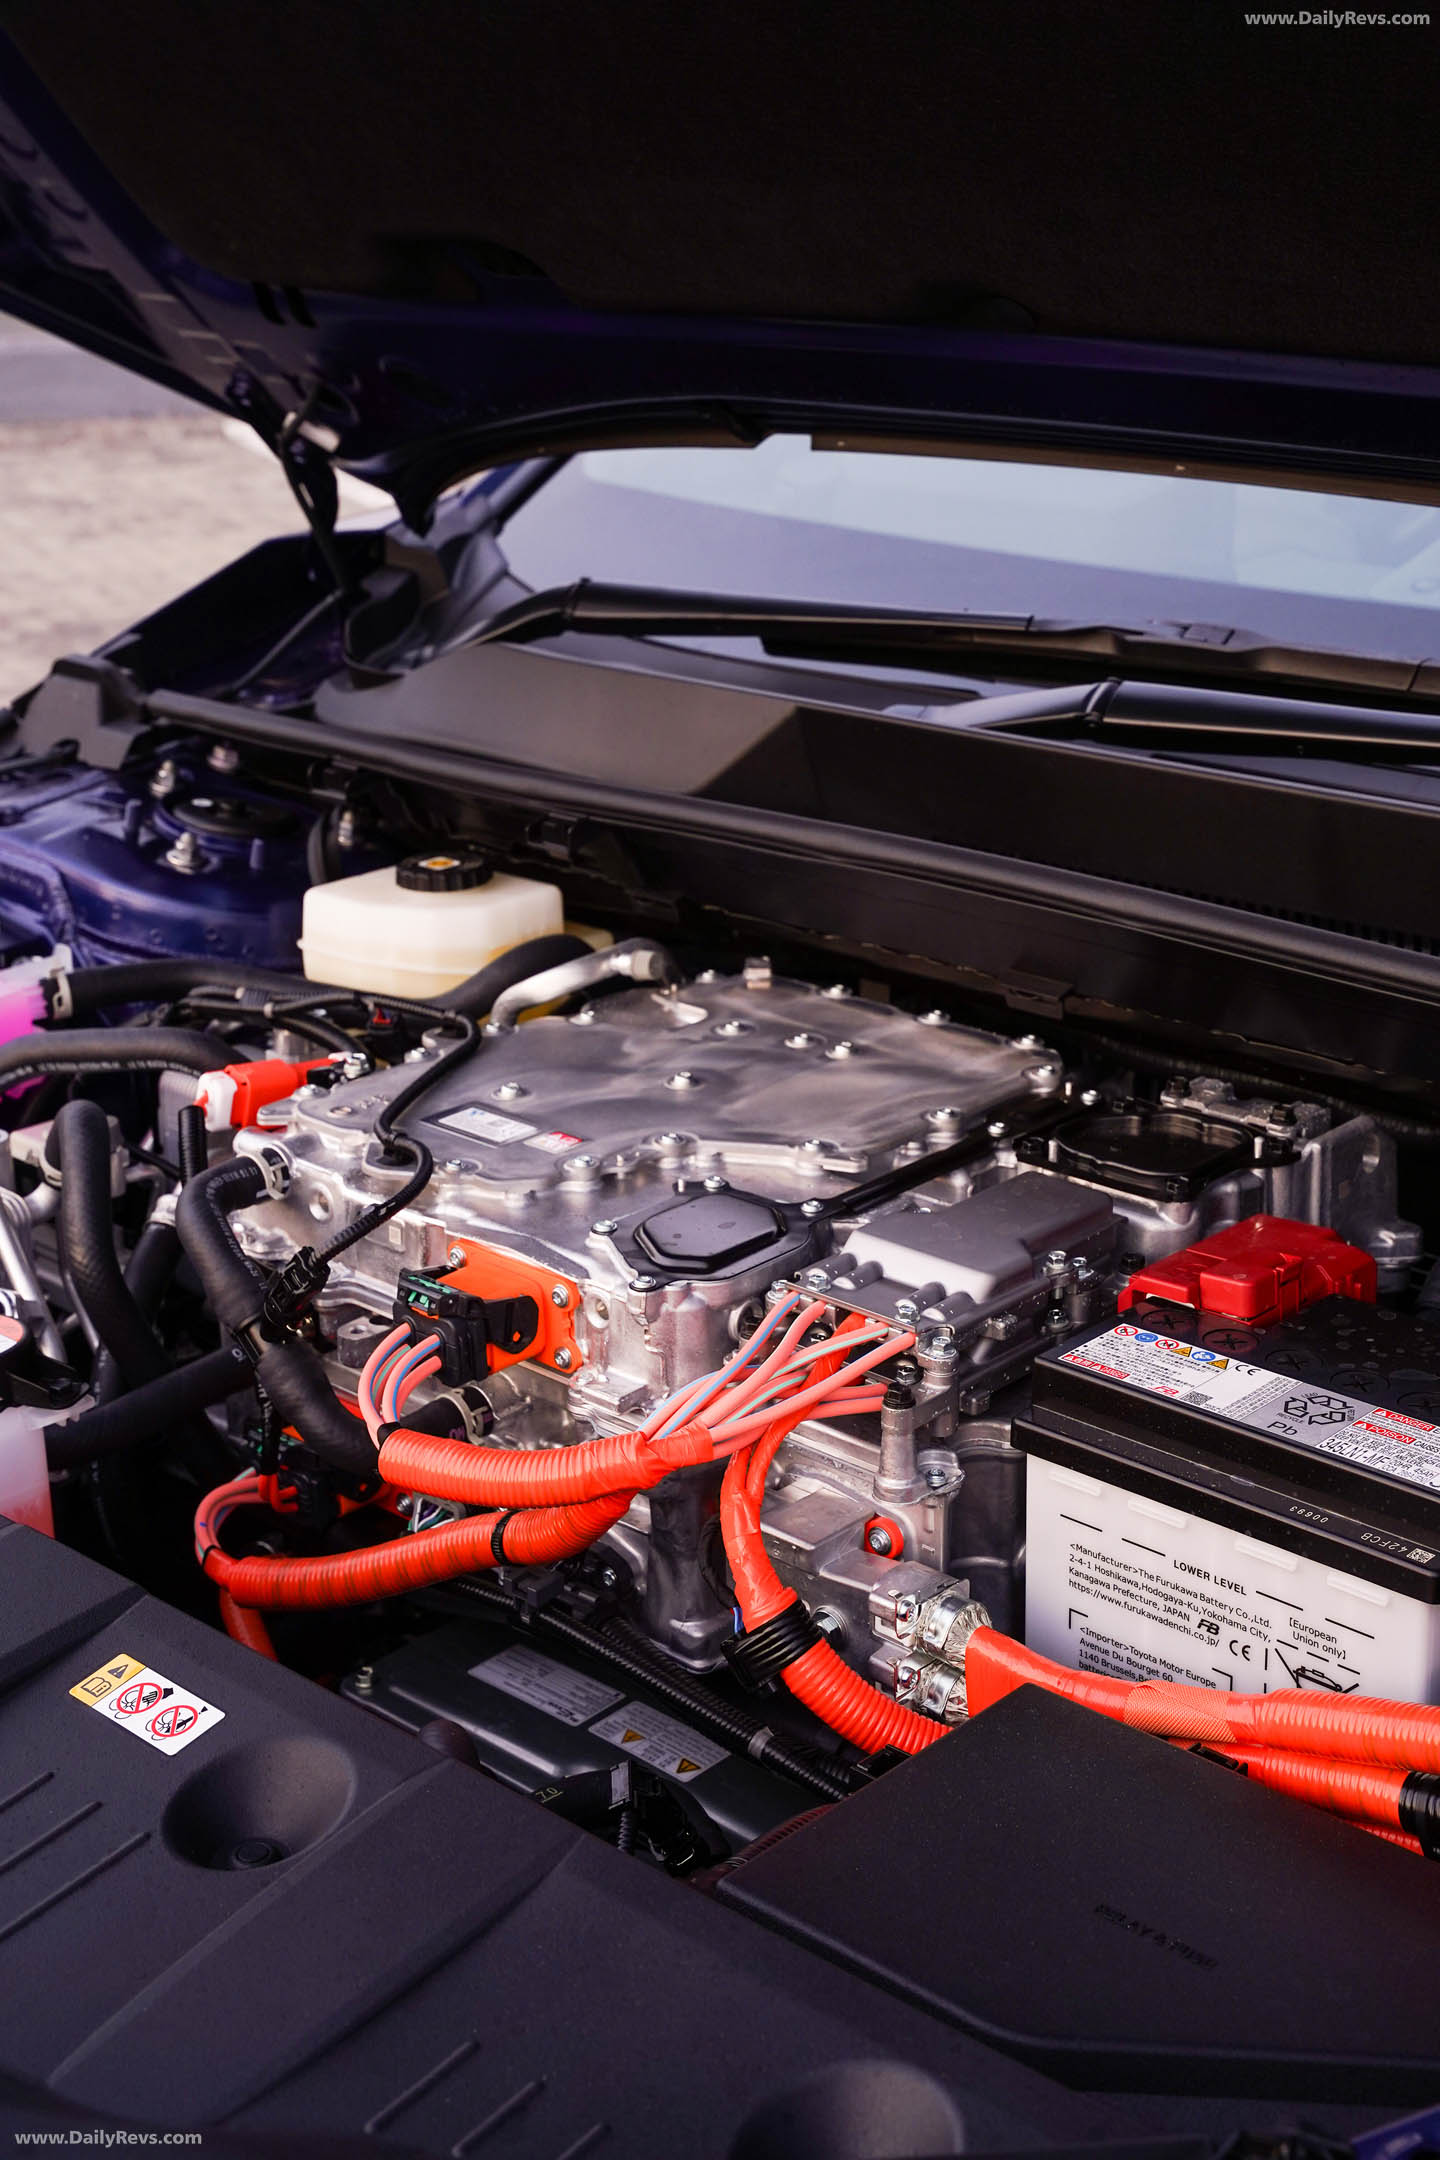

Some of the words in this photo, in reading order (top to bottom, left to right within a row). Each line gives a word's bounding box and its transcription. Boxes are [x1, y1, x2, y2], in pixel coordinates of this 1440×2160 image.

[1267, 1421, 1298, 1435] Pb
[1368, 1425, 1414, 1444] POISON
[1388, 1413, 1433, 1431] DANGER
[1319, 1438, 1390, 1466] 345LN1-MF
[1173, 1559, 1210, 1581] LOWER
[1214, 1575, 1247, 1596] LEVEL
[1069, 1566, 1110, 1590] Kanagawa
[1113, 1585, 1160, 1611] Prefecture,
[1162, 1604, 1190, 1622] JAPAN
[1069, 1553, 1091, 1570] 2-4-1
[1249, 1626, 1271, 1643] City,
[1156, 1575, 1198, 1599] Furukawa
[1200, 1592, 1234, 1614] Battery
[1236, 1607, 1272, 1629] Co.,Ltd.
[1069, 1579, 1220, 1648] https://www.furukawadenchi.co.jp/
[1293, 1631, 1319, 1648] Union
[1079, 1649, 1099, 1664] 1140
[1080, 1638, 1109, 1656] Avenue
[1112, 1650, 1123, 1662] Du
[1126, 1656, 1160, 1677] Bourget
[1162, 1672, 1173, 1683] 60
[1159, 1658, 1184, 1675] Motor
[1186, 1669, 1216, 1689] Europe
